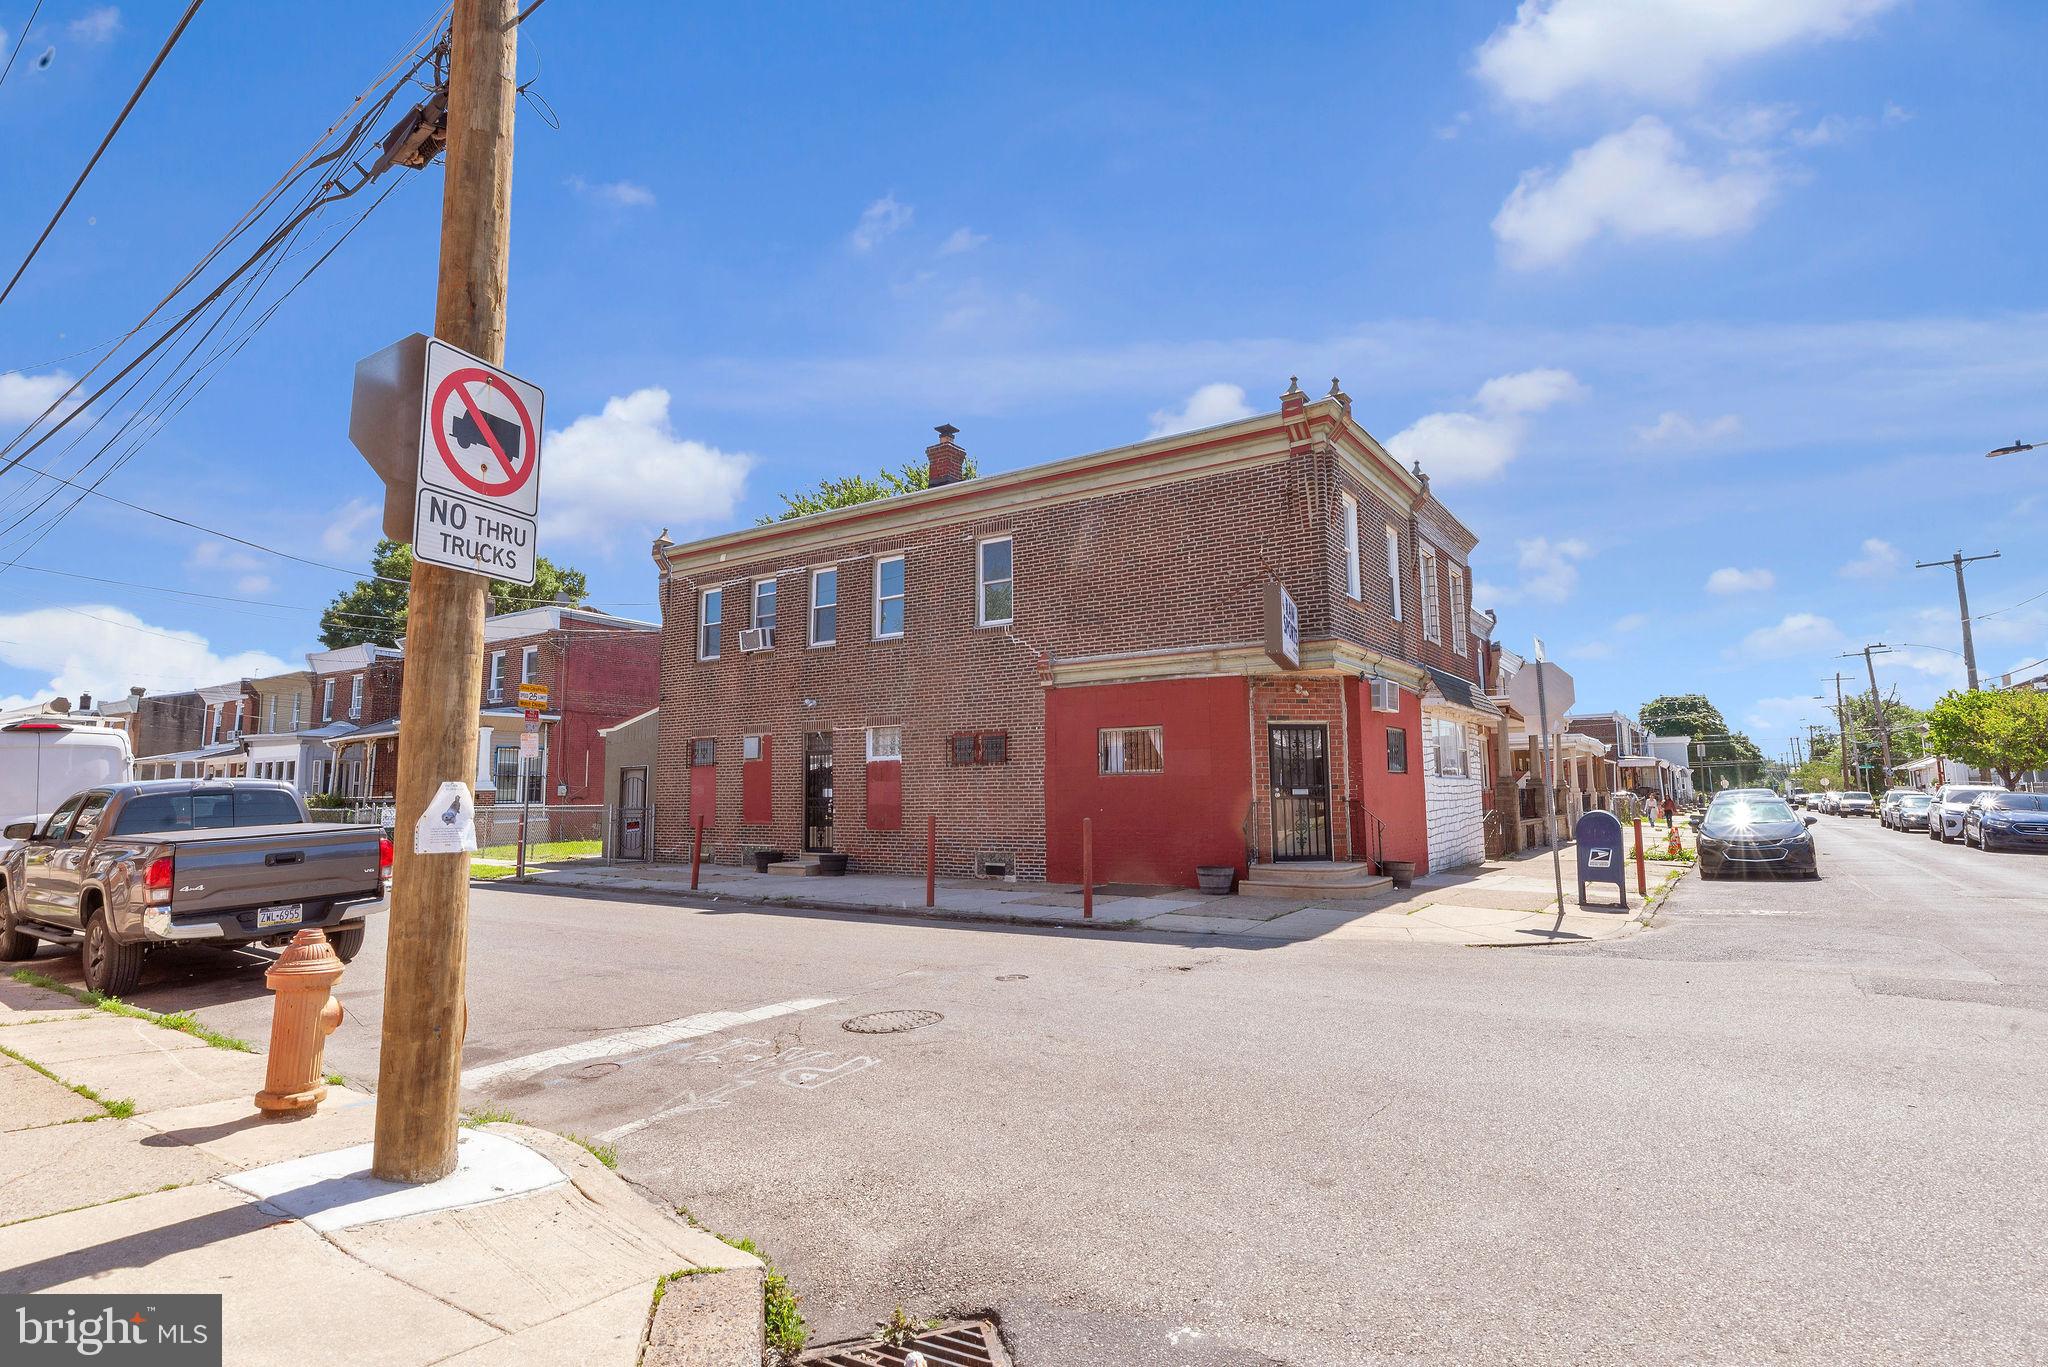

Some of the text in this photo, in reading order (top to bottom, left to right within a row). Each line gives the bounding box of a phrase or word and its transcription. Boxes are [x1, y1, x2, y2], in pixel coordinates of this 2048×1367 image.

[430, 496, 527, 547] NO THRU
[440, 531, 517, 570] TRUCKS
[529, 692, 538, 701] 25
